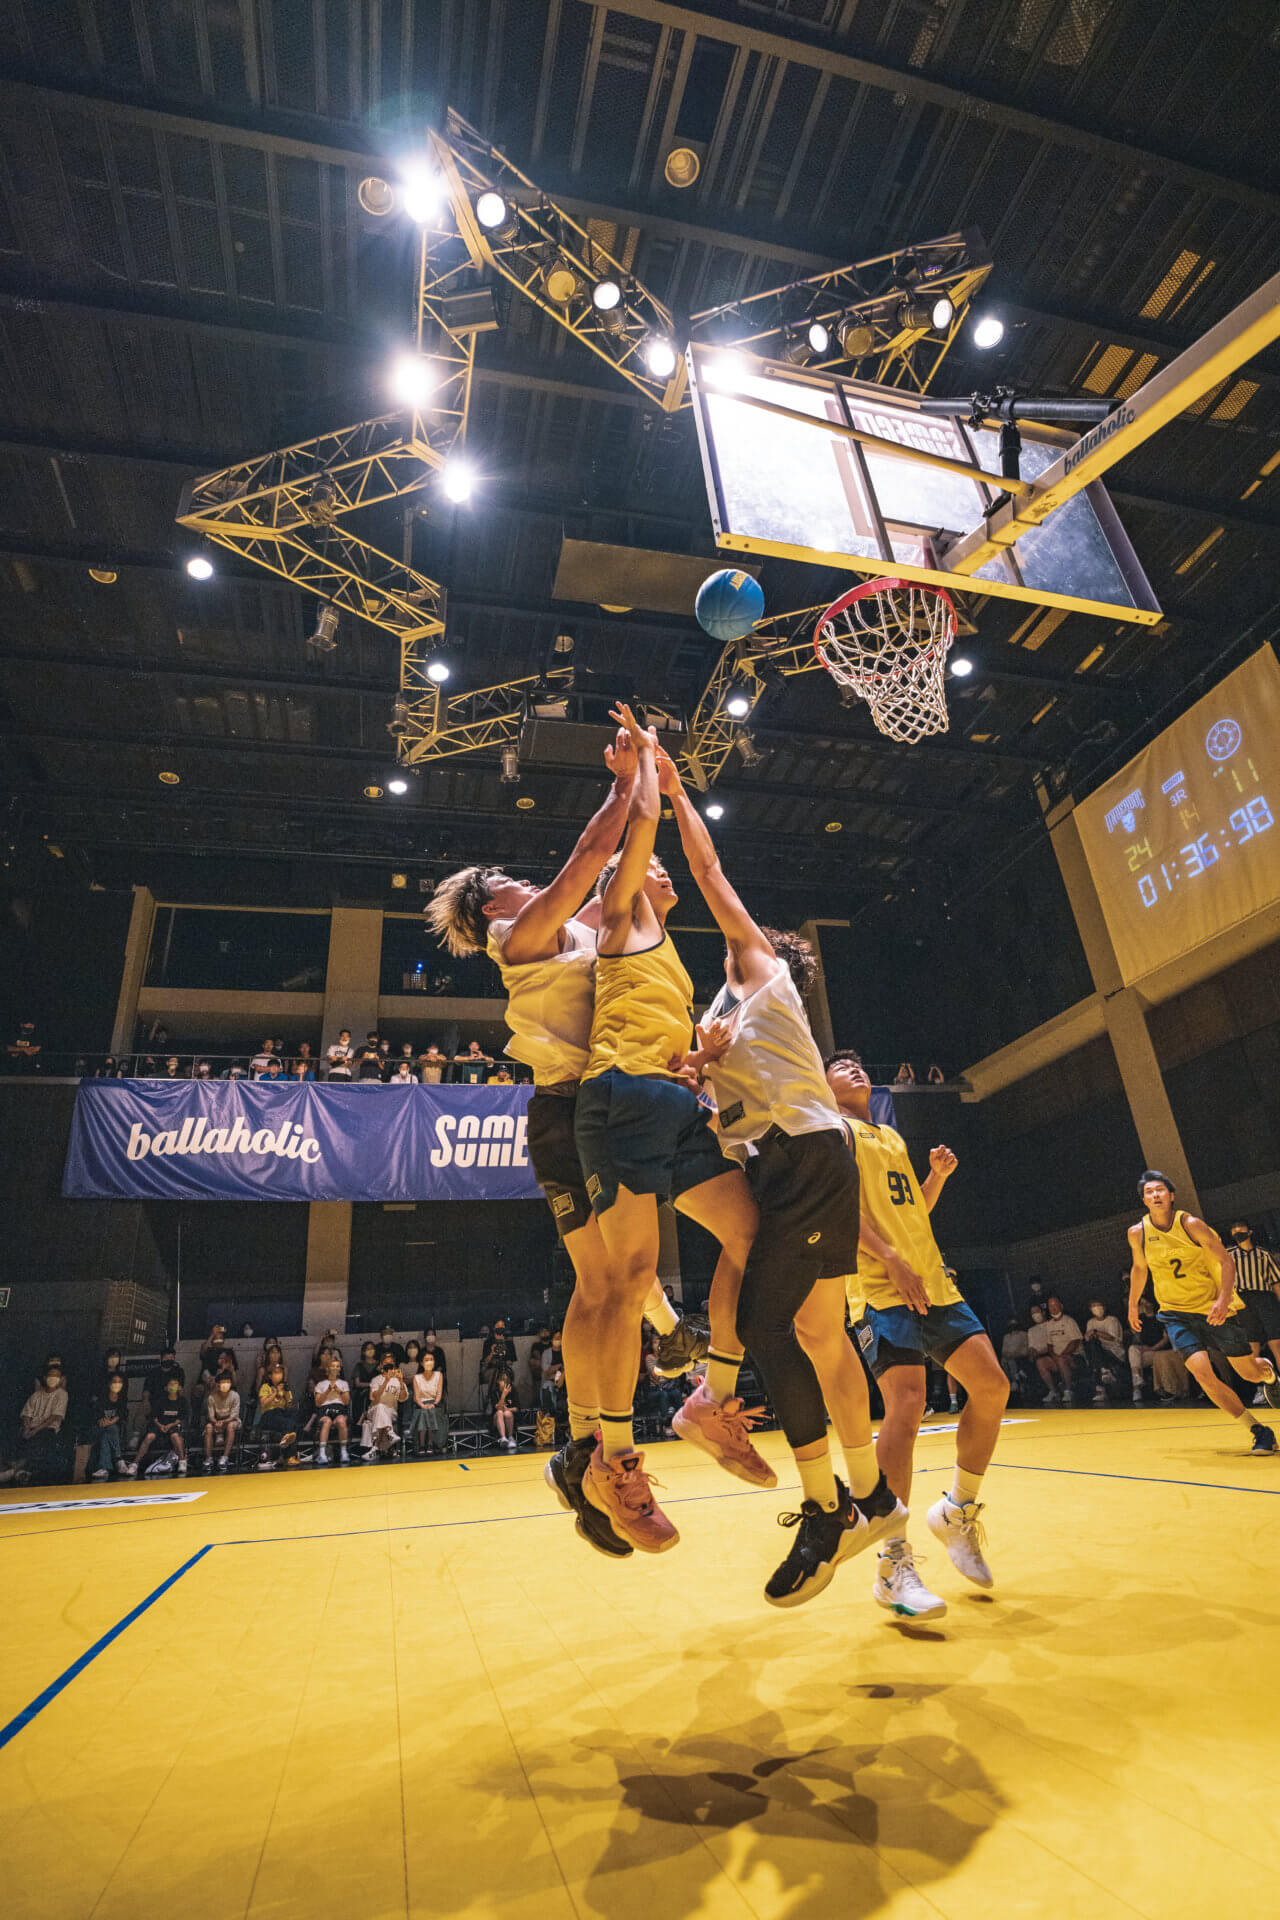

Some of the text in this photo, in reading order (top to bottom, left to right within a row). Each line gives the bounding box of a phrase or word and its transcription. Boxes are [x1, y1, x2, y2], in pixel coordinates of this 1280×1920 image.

[1064, 407, 1136, 475] ballaholic
[1169, 788, 1188, 808] 3R
[1124, 837, 1153, 873] 24
[126, 1116, 322, 1164] ballaholic
[887, 1170, 915, 1206] 93
[1169, 1258, 1187, 1279] 2
